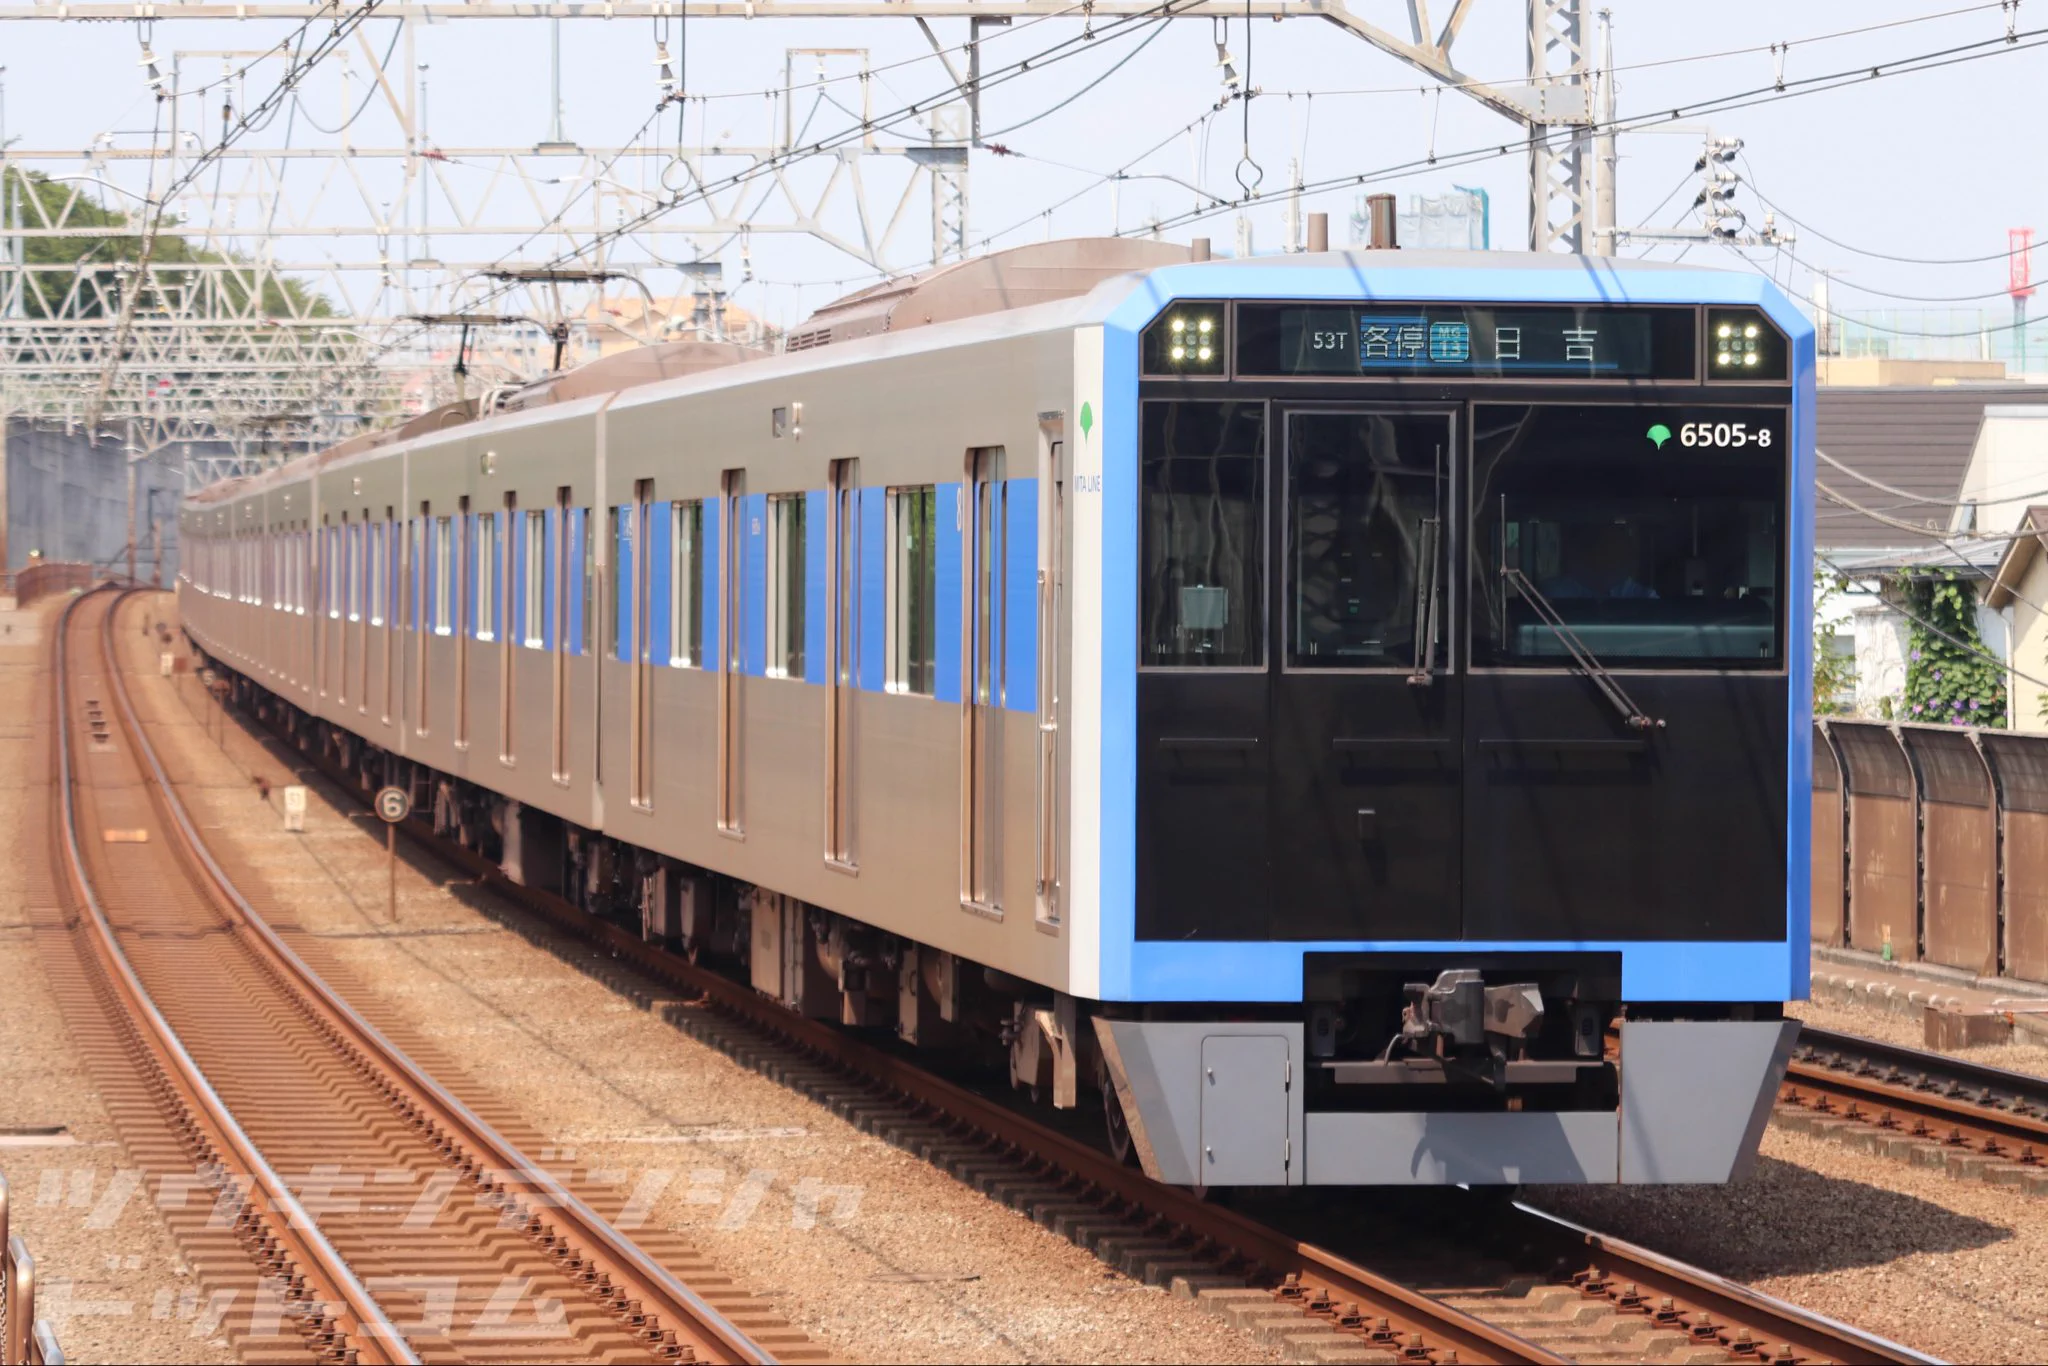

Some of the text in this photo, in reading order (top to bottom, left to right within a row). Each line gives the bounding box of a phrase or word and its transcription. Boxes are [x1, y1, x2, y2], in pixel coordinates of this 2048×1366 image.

[1313, 332, 1348, 350] 53T
[1363, 326, 1425, 358] 各停
[1438, 327, 1461, 339] MG
[1440, 341, 1461, 357] 13
[1680, 423, 1771, 447] 6505-8
[383, 792, 402, 817] 6
